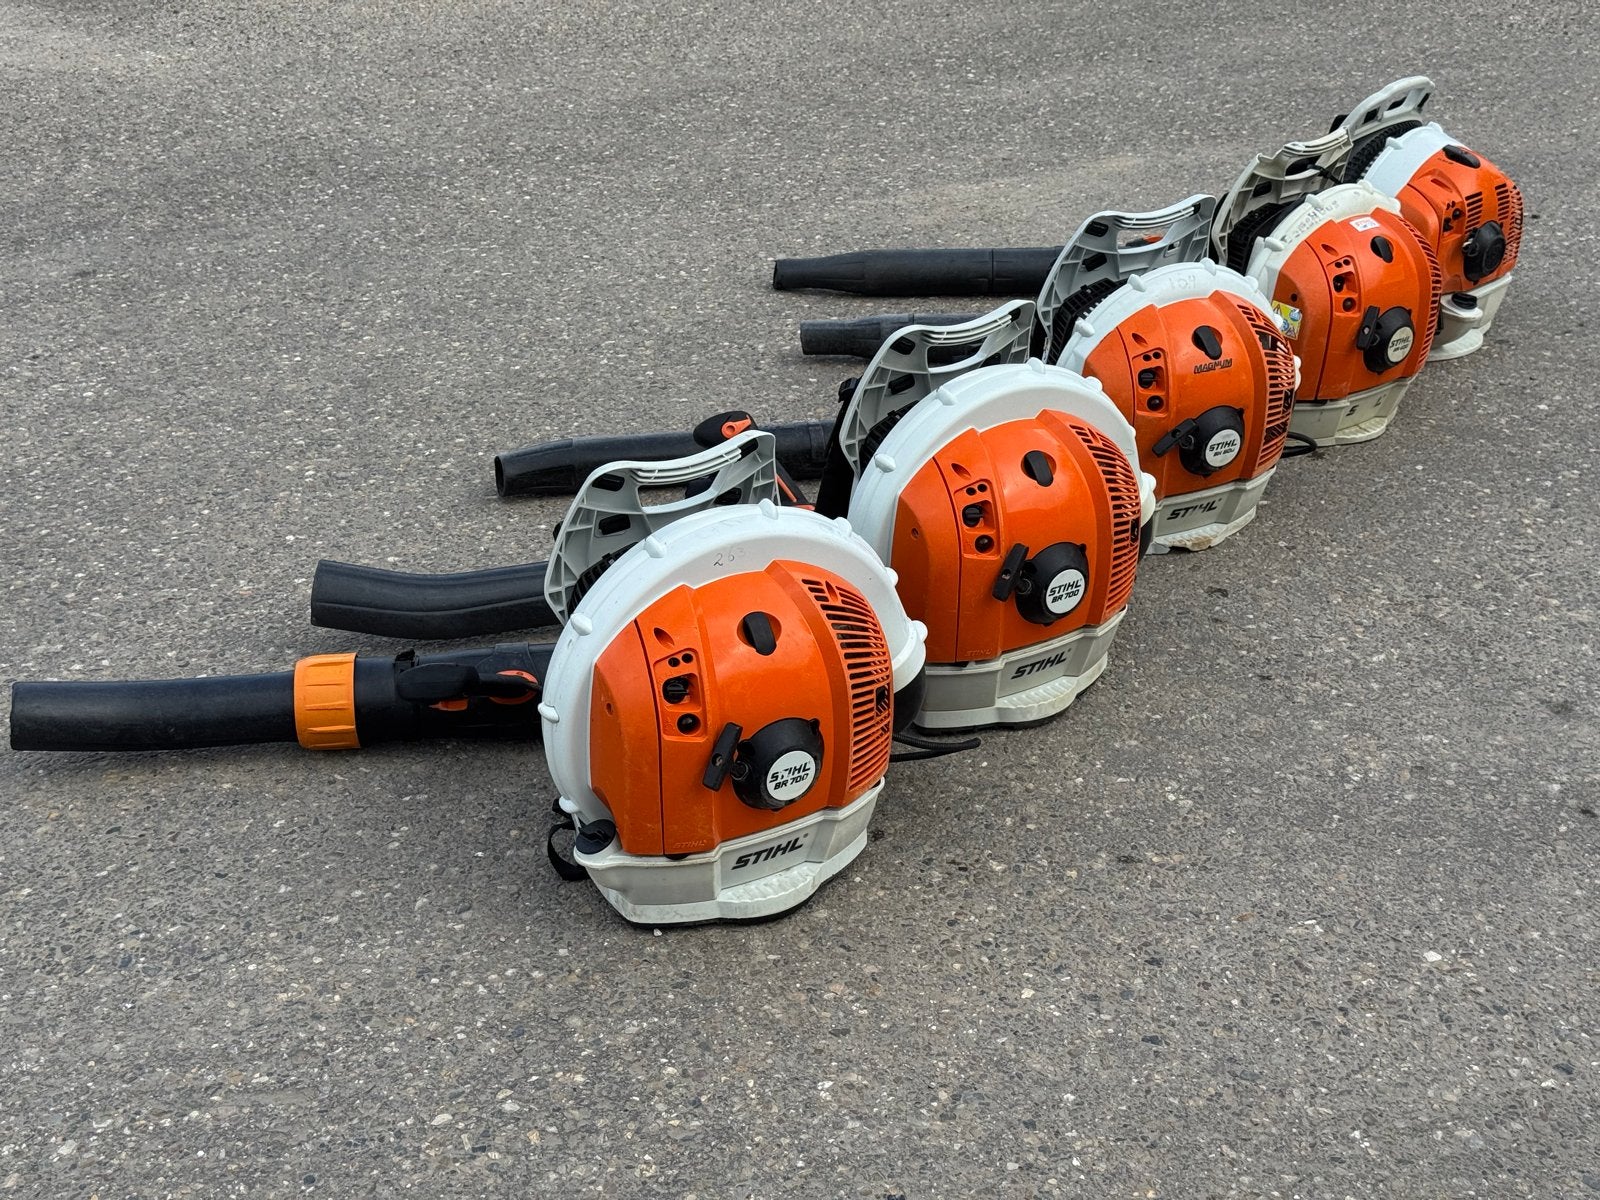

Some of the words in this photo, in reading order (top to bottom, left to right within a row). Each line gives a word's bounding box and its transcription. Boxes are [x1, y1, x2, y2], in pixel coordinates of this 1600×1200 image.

[1193, 358, 1232, 374] MAGNUM
[1208, 439, 1237, 452] STIHL
[1048, 580, 1082, 597] STIHL
[1051, 594, 1063, 604] BR
[1064, 589, 1080, 600] 700
[1010, 651, 1067, 680] STIHL
[773, 780, 789, 791] BR
[790, 773, 809, 785] 700
[731, 837, 803, 870] STIHL
